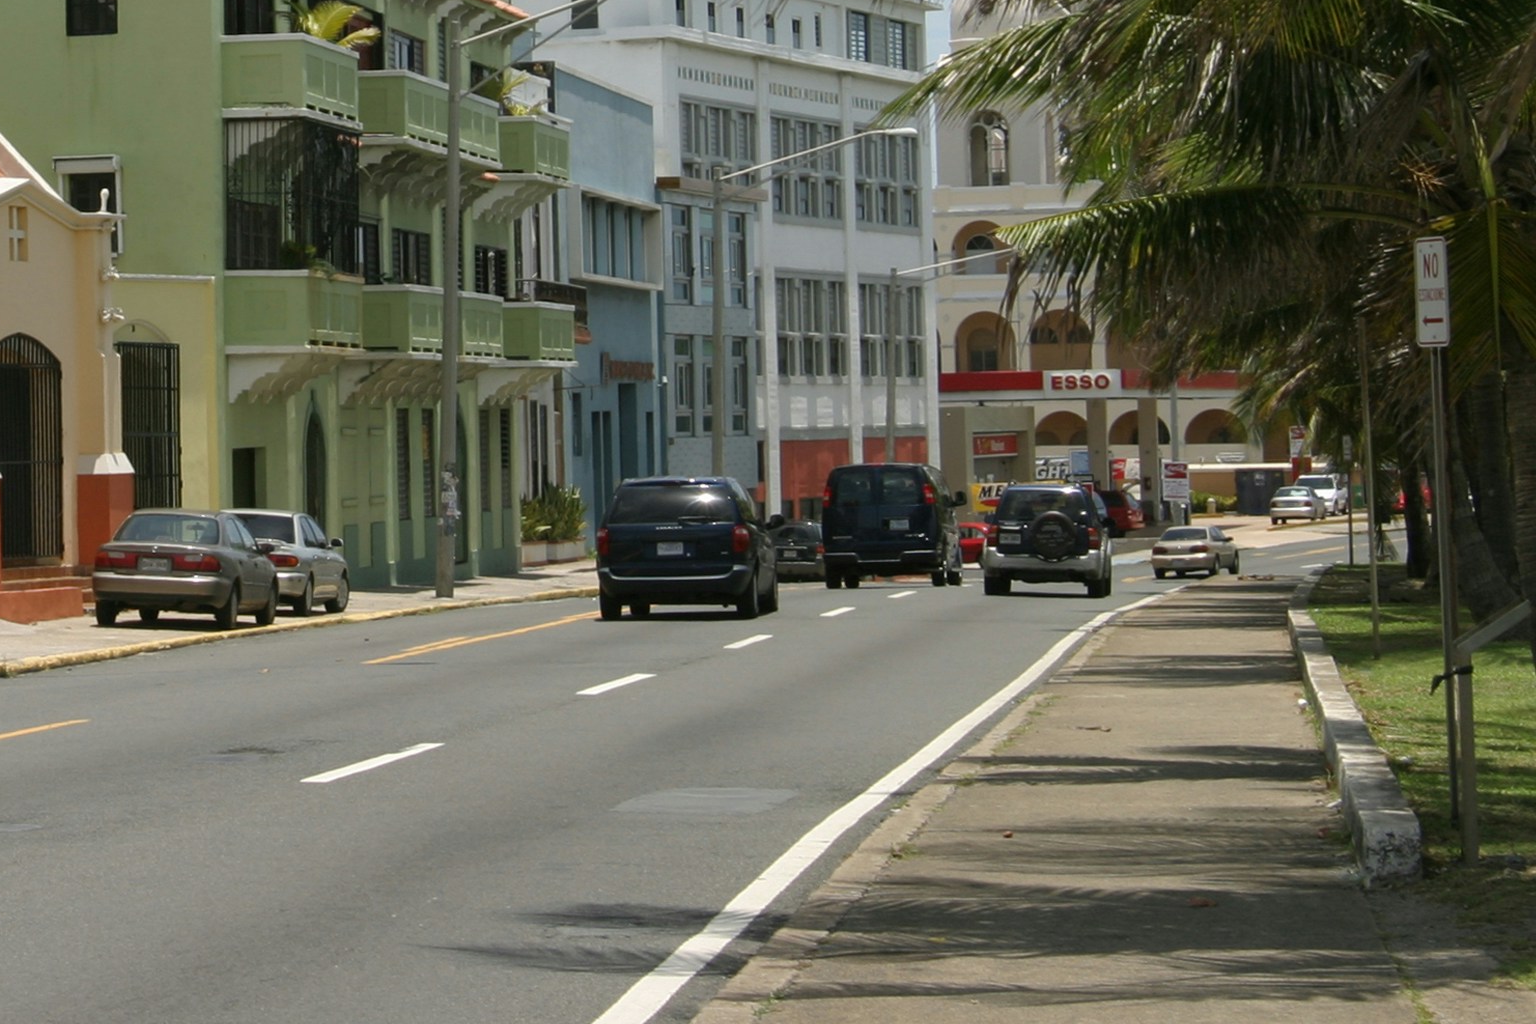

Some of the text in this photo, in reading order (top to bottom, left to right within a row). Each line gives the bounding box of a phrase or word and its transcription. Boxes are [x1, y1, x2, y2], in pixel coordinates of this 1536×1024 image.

[1423, 253, 1439, 278] NO
[1051, 374, 1110, 390] ESSO
[1035, 466, 1070, 480] GHT
